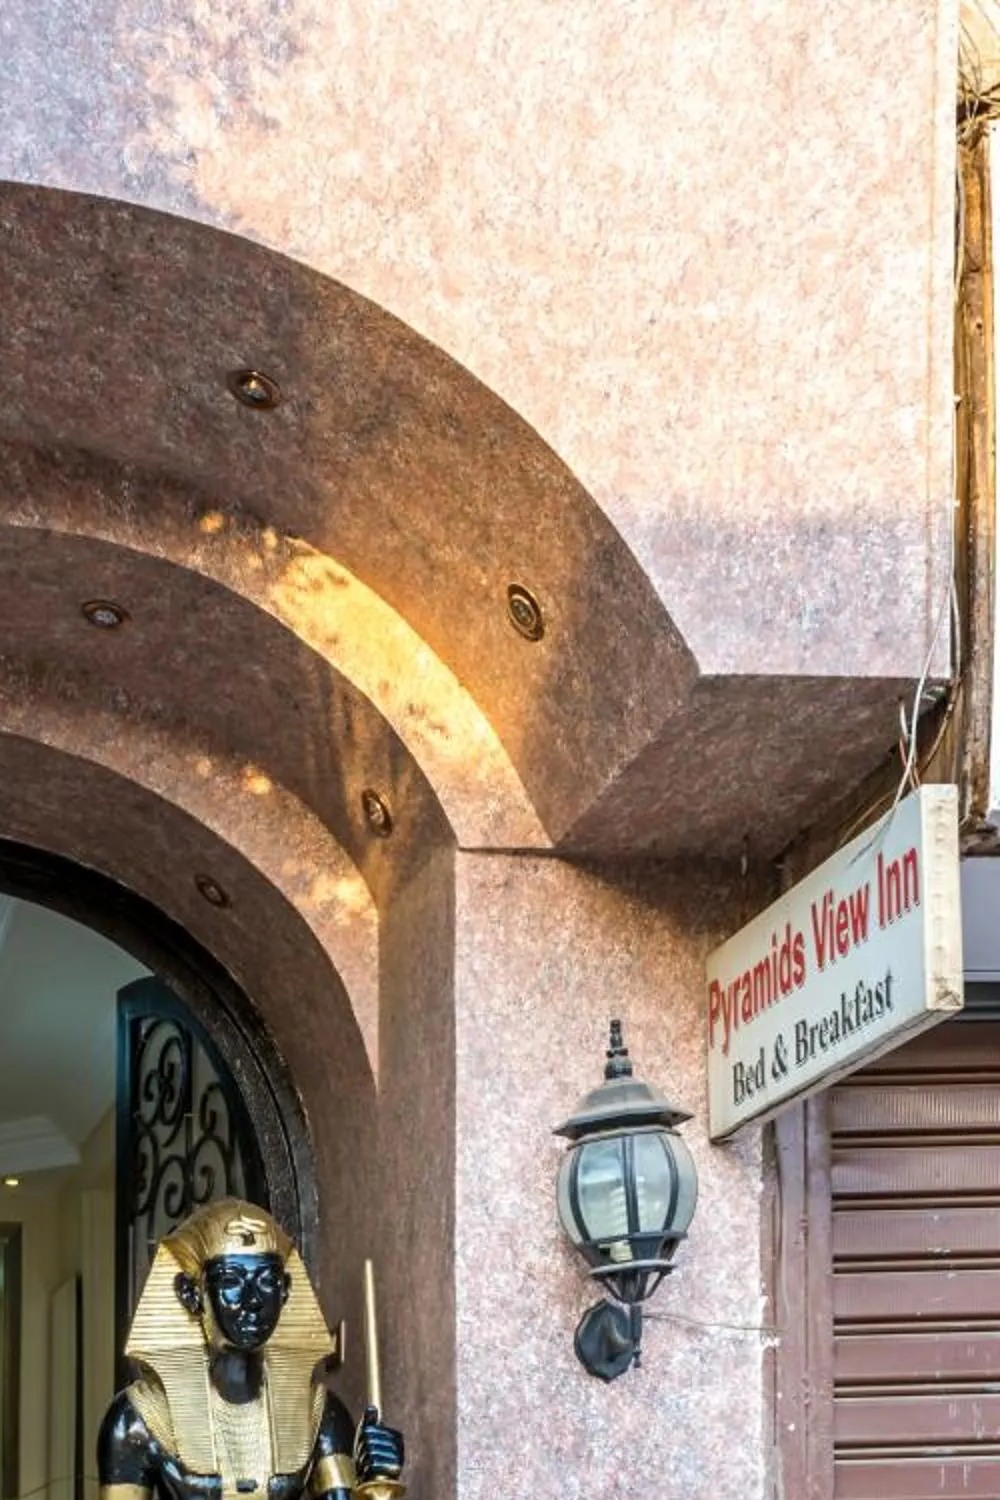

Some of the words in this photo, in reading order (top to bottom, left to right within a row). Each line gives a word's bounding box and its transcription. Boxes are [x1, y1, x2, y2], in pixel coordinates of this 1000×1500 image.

[708, 922, 806, 1055] Pyramids
[811, 882, 870, 971] View
[877, 847, 921, 930] Inn
[733, 1048, 766, 1105] Bed
[770, 1034, 789, 1080] &
[795, 966, 895, 1065] Breakfast
